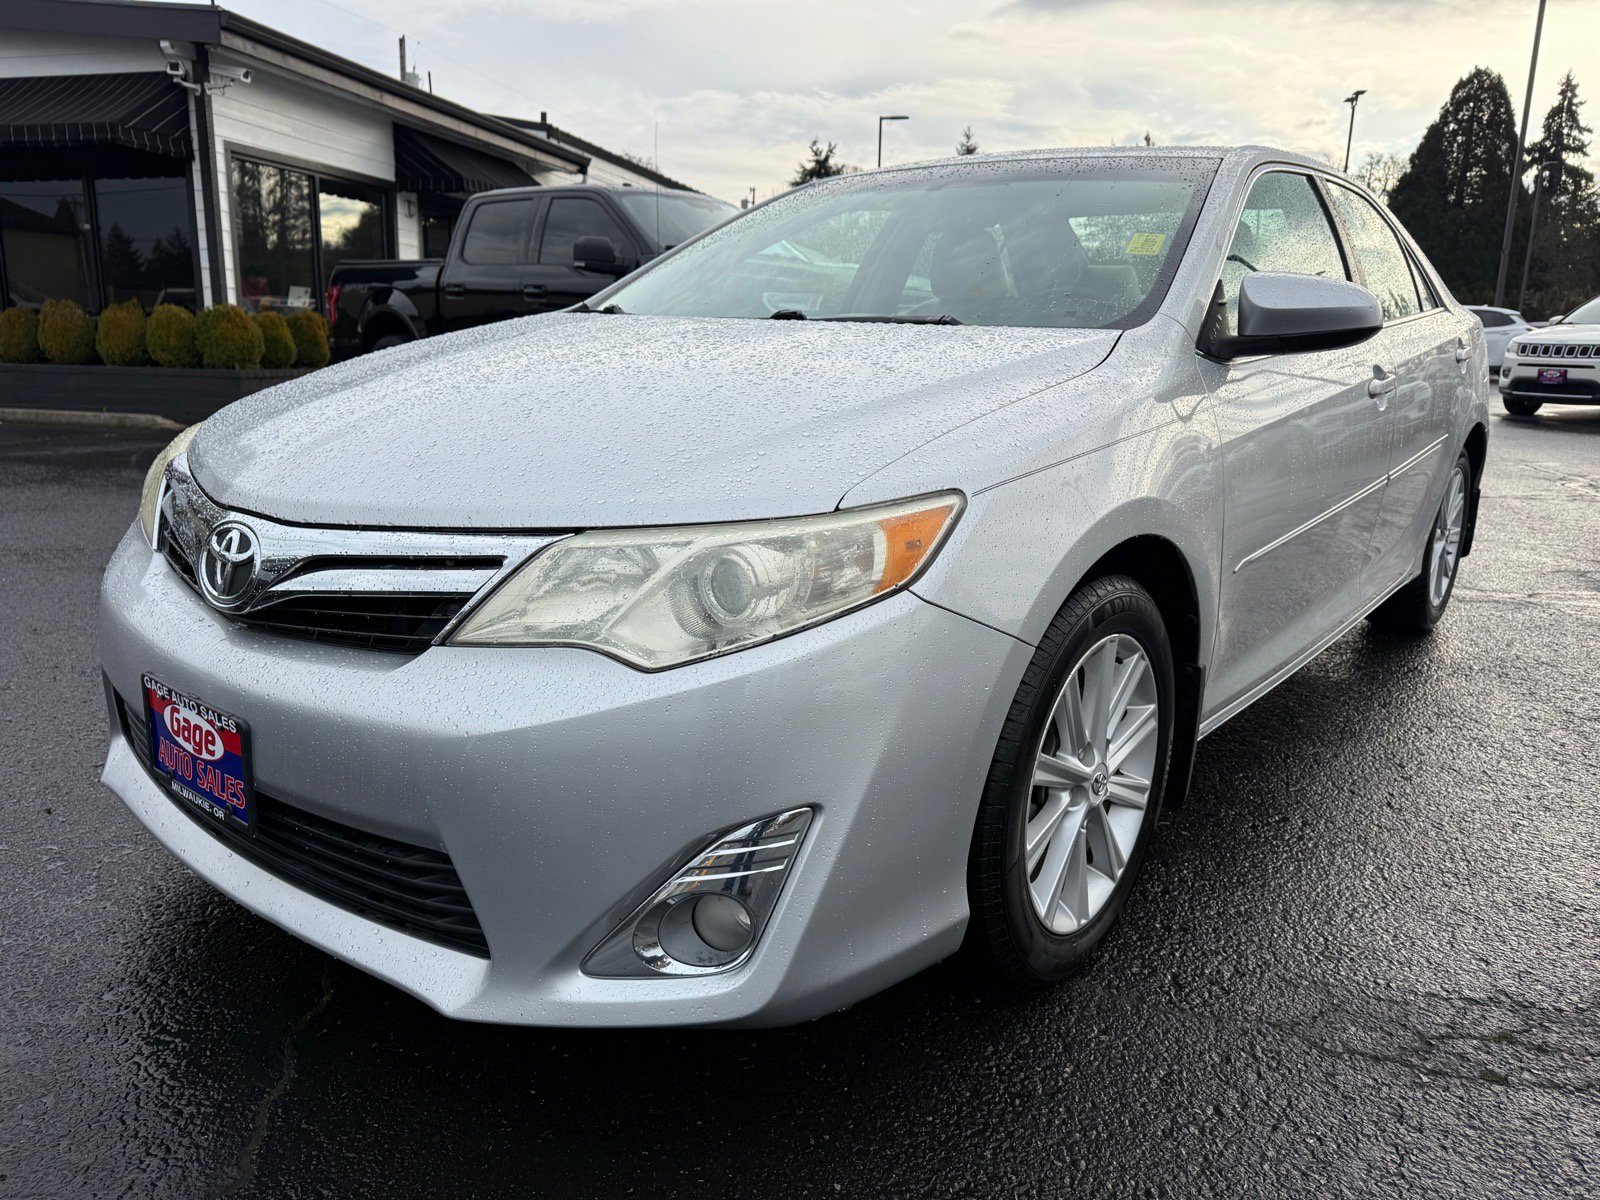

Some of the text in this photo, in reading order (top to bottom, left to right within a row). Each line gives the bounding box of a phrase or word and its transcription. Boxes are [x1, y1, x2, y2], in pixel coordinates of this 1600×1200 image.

[144, 676, 236, 733] GAGE AUTO SALES
[169, 705, 216, 757] Gage
[159, 737, 246, 809] AUTO SALES
[213, 807, 225, 820] OR
